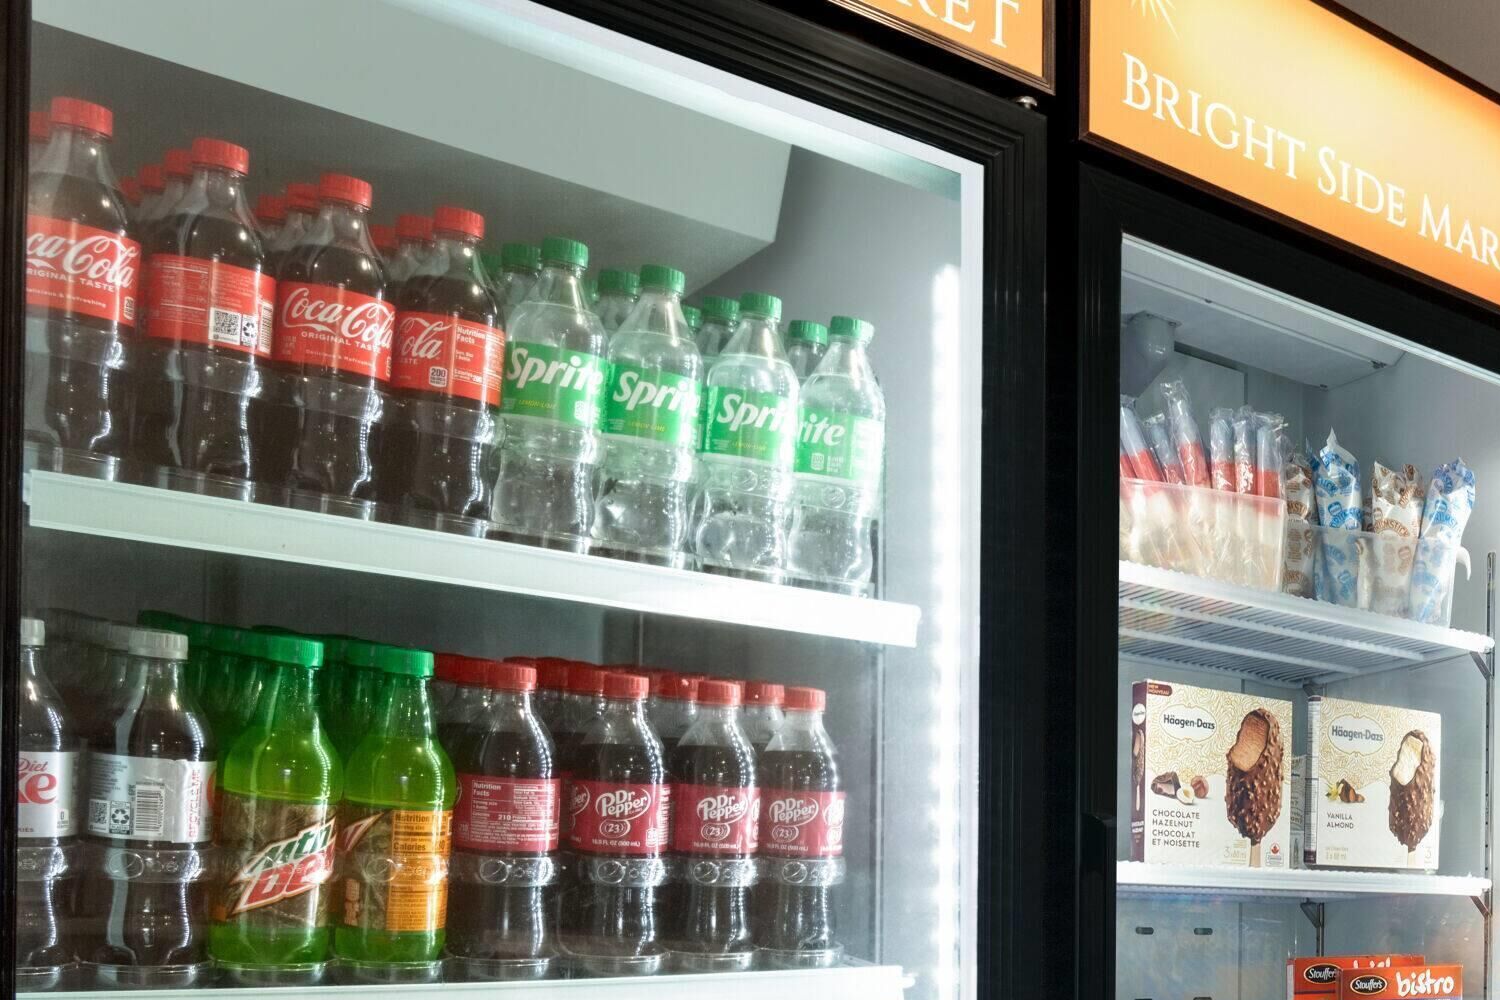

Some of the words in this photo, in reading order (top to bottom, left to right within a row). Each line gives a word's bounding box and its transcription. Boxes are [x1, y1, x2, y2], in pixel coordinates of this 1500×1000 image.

[1122, 52, 1306, 179] BRIGHT
[1317, 146, 1407, 228] SIDE
[26, 267, 74, 283] RIGINAL
[79, 277, 114, 292] TASTE
[281, 287, 395, 349] Coca-Cola
[457, 325, 486, 339] Nutrition
[301, 331, 351, 346] ORIGINAL
[456, 333, 475, 345] Facts
[430, 367, 447, 377] 200
[506, 347, 604, 395] Sprite
[1163, 714, 1215, 731] Häagen-Dazs
[1331, 725, 1384, 743] Häagen-Dazs
[18, 759, 48, 772] Diet
[473, 782, 501, 791] Nutrition
[473, 789, 490, 797] Facts
[615, 790, 635, 802] Dr
[596, 792, 648, 818] Pepper
[717, 794, 736, 806] Dr
[786, 797, 804, 809] Dr
[697, 797, 745, 821] Pepper
[770, 800, 816, 824] Pepper
[1152, 809, 1200, 820] CHOCOLATE
[1326, 812, 1353, 821] VANILLA
[608, 824, 620, 833] 23
[1152, 818, 1193, 828] HAZELNUT
[1326, 821, 1354, 830] ALMOND
[1152, 829, 1195, 839] CHOCOLAT
[394, 842, 426, 851] Calories
[1152, 838, 1161, 847] ET
[1163, 838, 1200, 849] NOISETTE
[1354, 979, 1383, 991] Stouffer's
[1396, 969, 1455, 997] bistro
